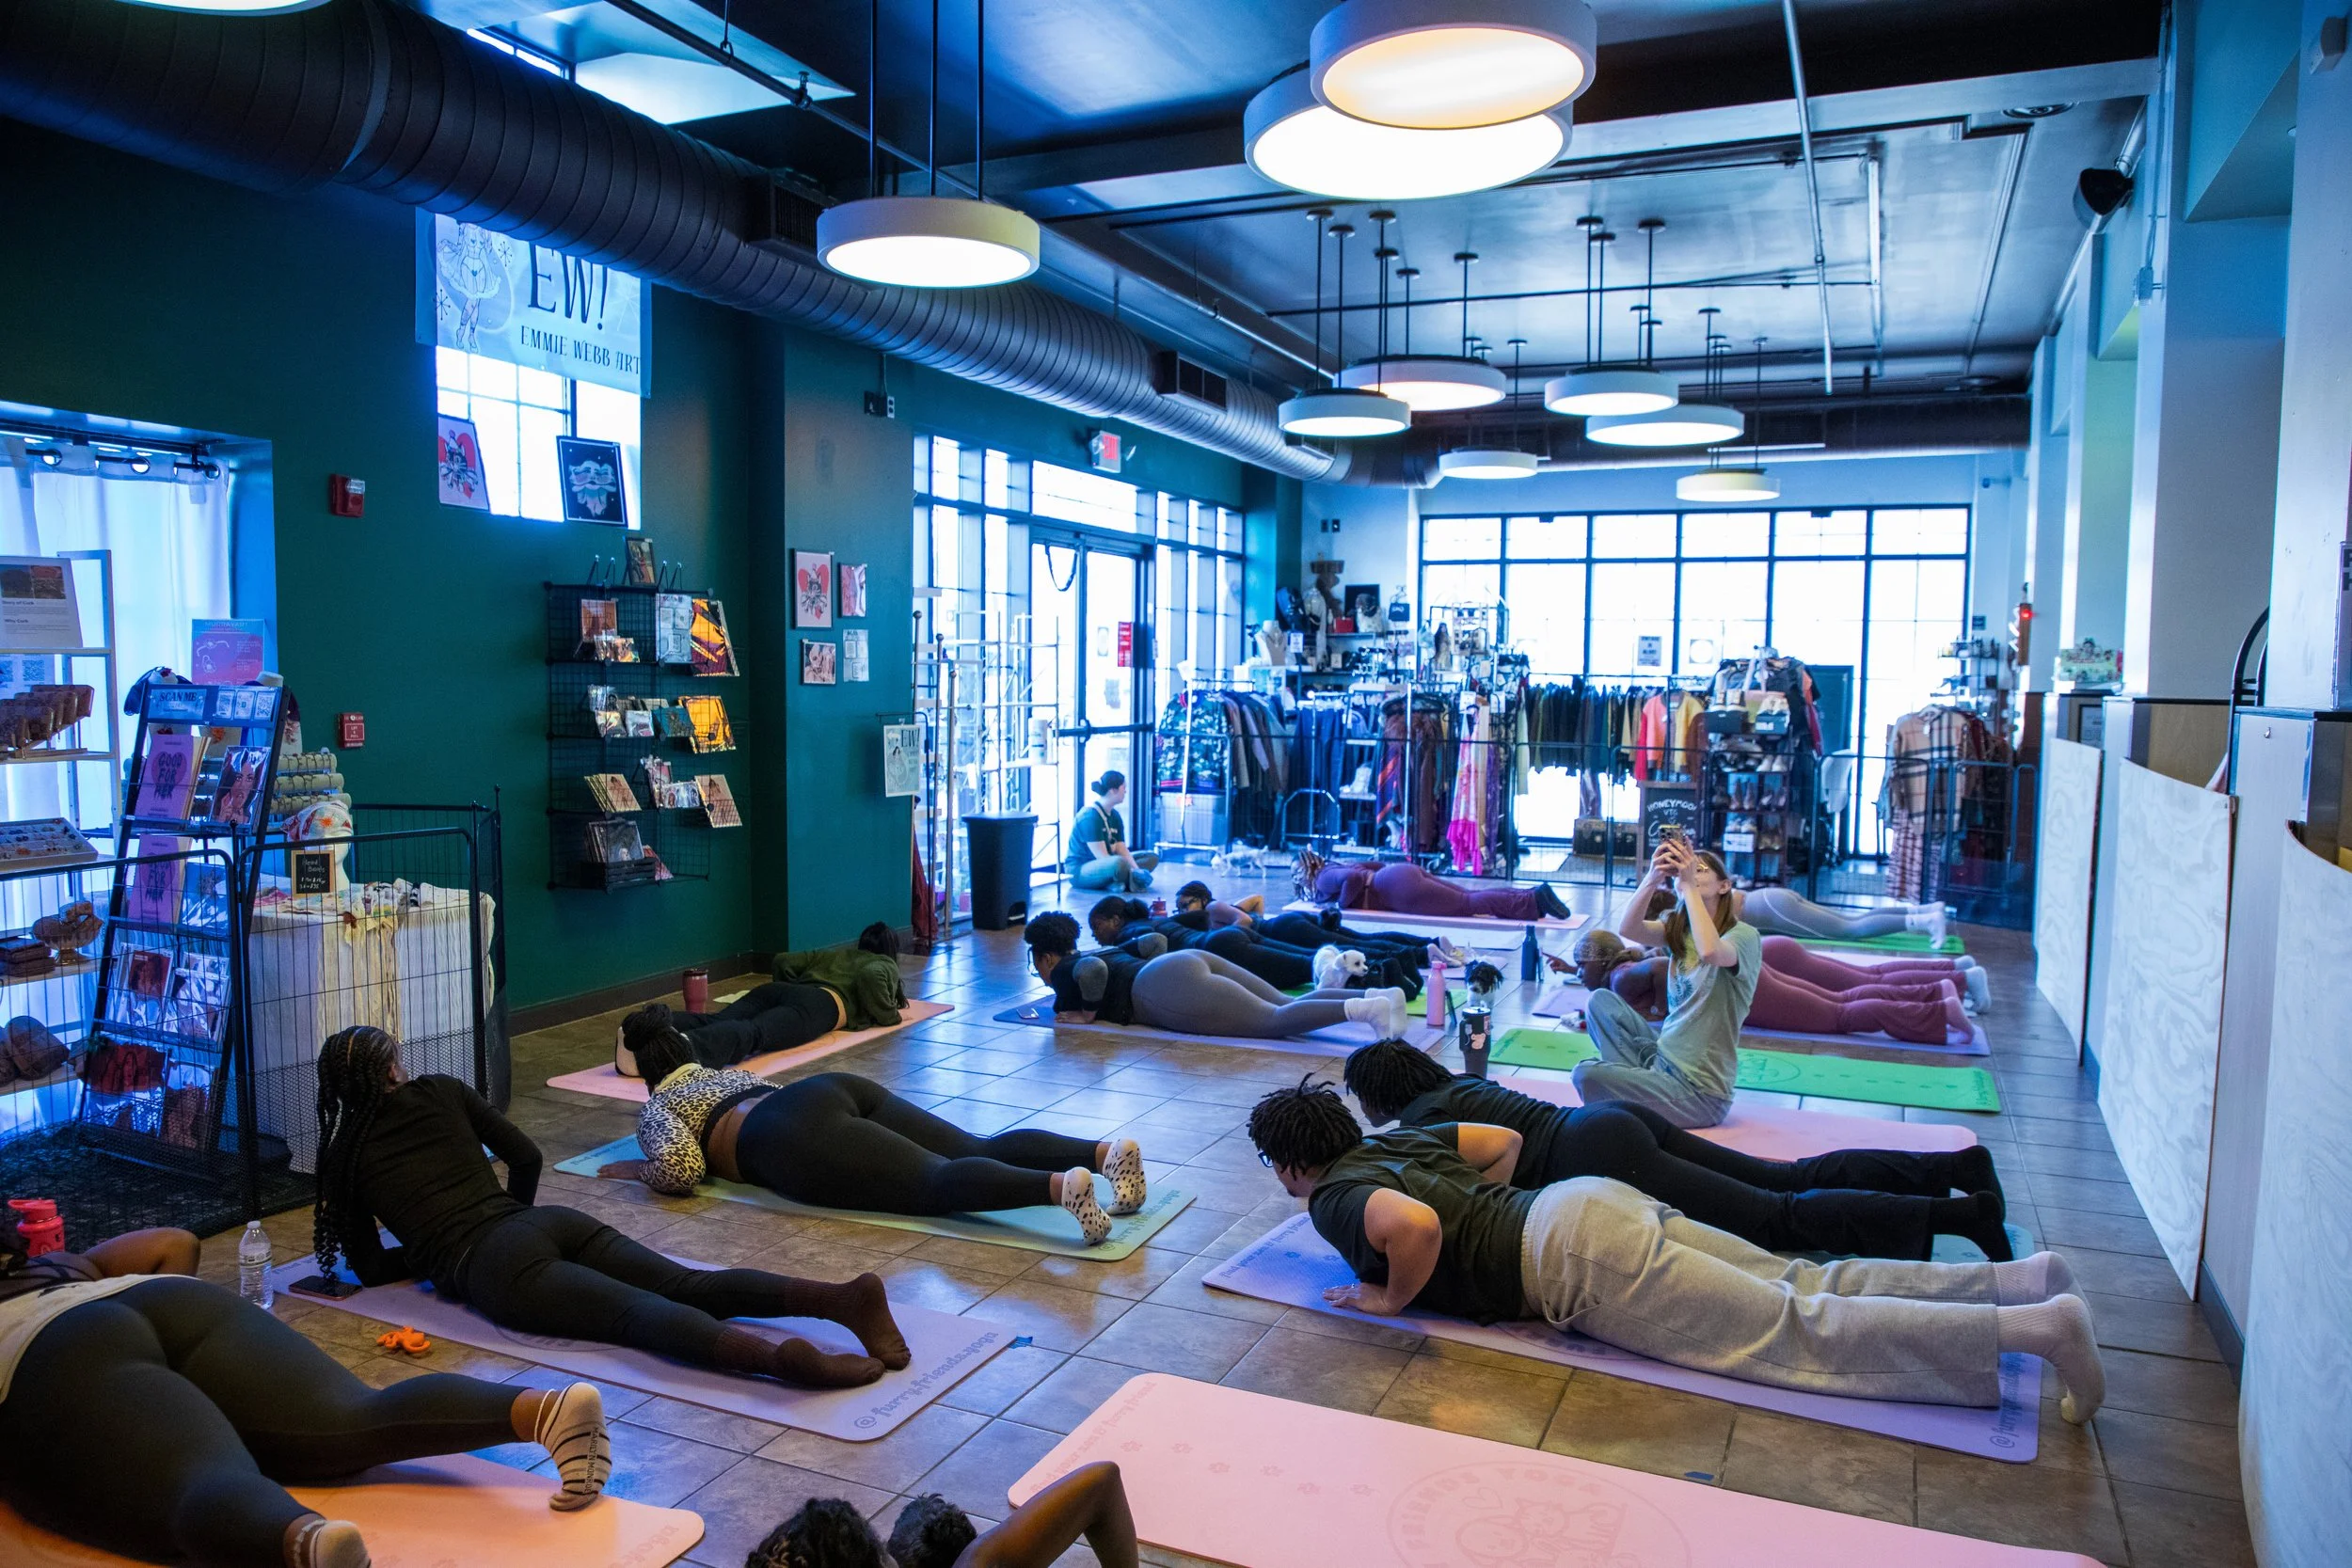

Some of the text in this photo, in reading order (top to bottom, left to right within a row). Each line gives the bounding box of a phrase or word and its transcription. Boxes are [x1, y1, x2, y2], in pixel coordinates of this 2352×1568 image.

[528, 242, 608, 330] EW!
[520, 325, 640, 374] EMMIE WEBB ART
[160, 691, 198, 702] SCAN ME
[158, 752, 183, 768] GOOD
[584, 1427, 599, 1494] MARILYN MONROE
